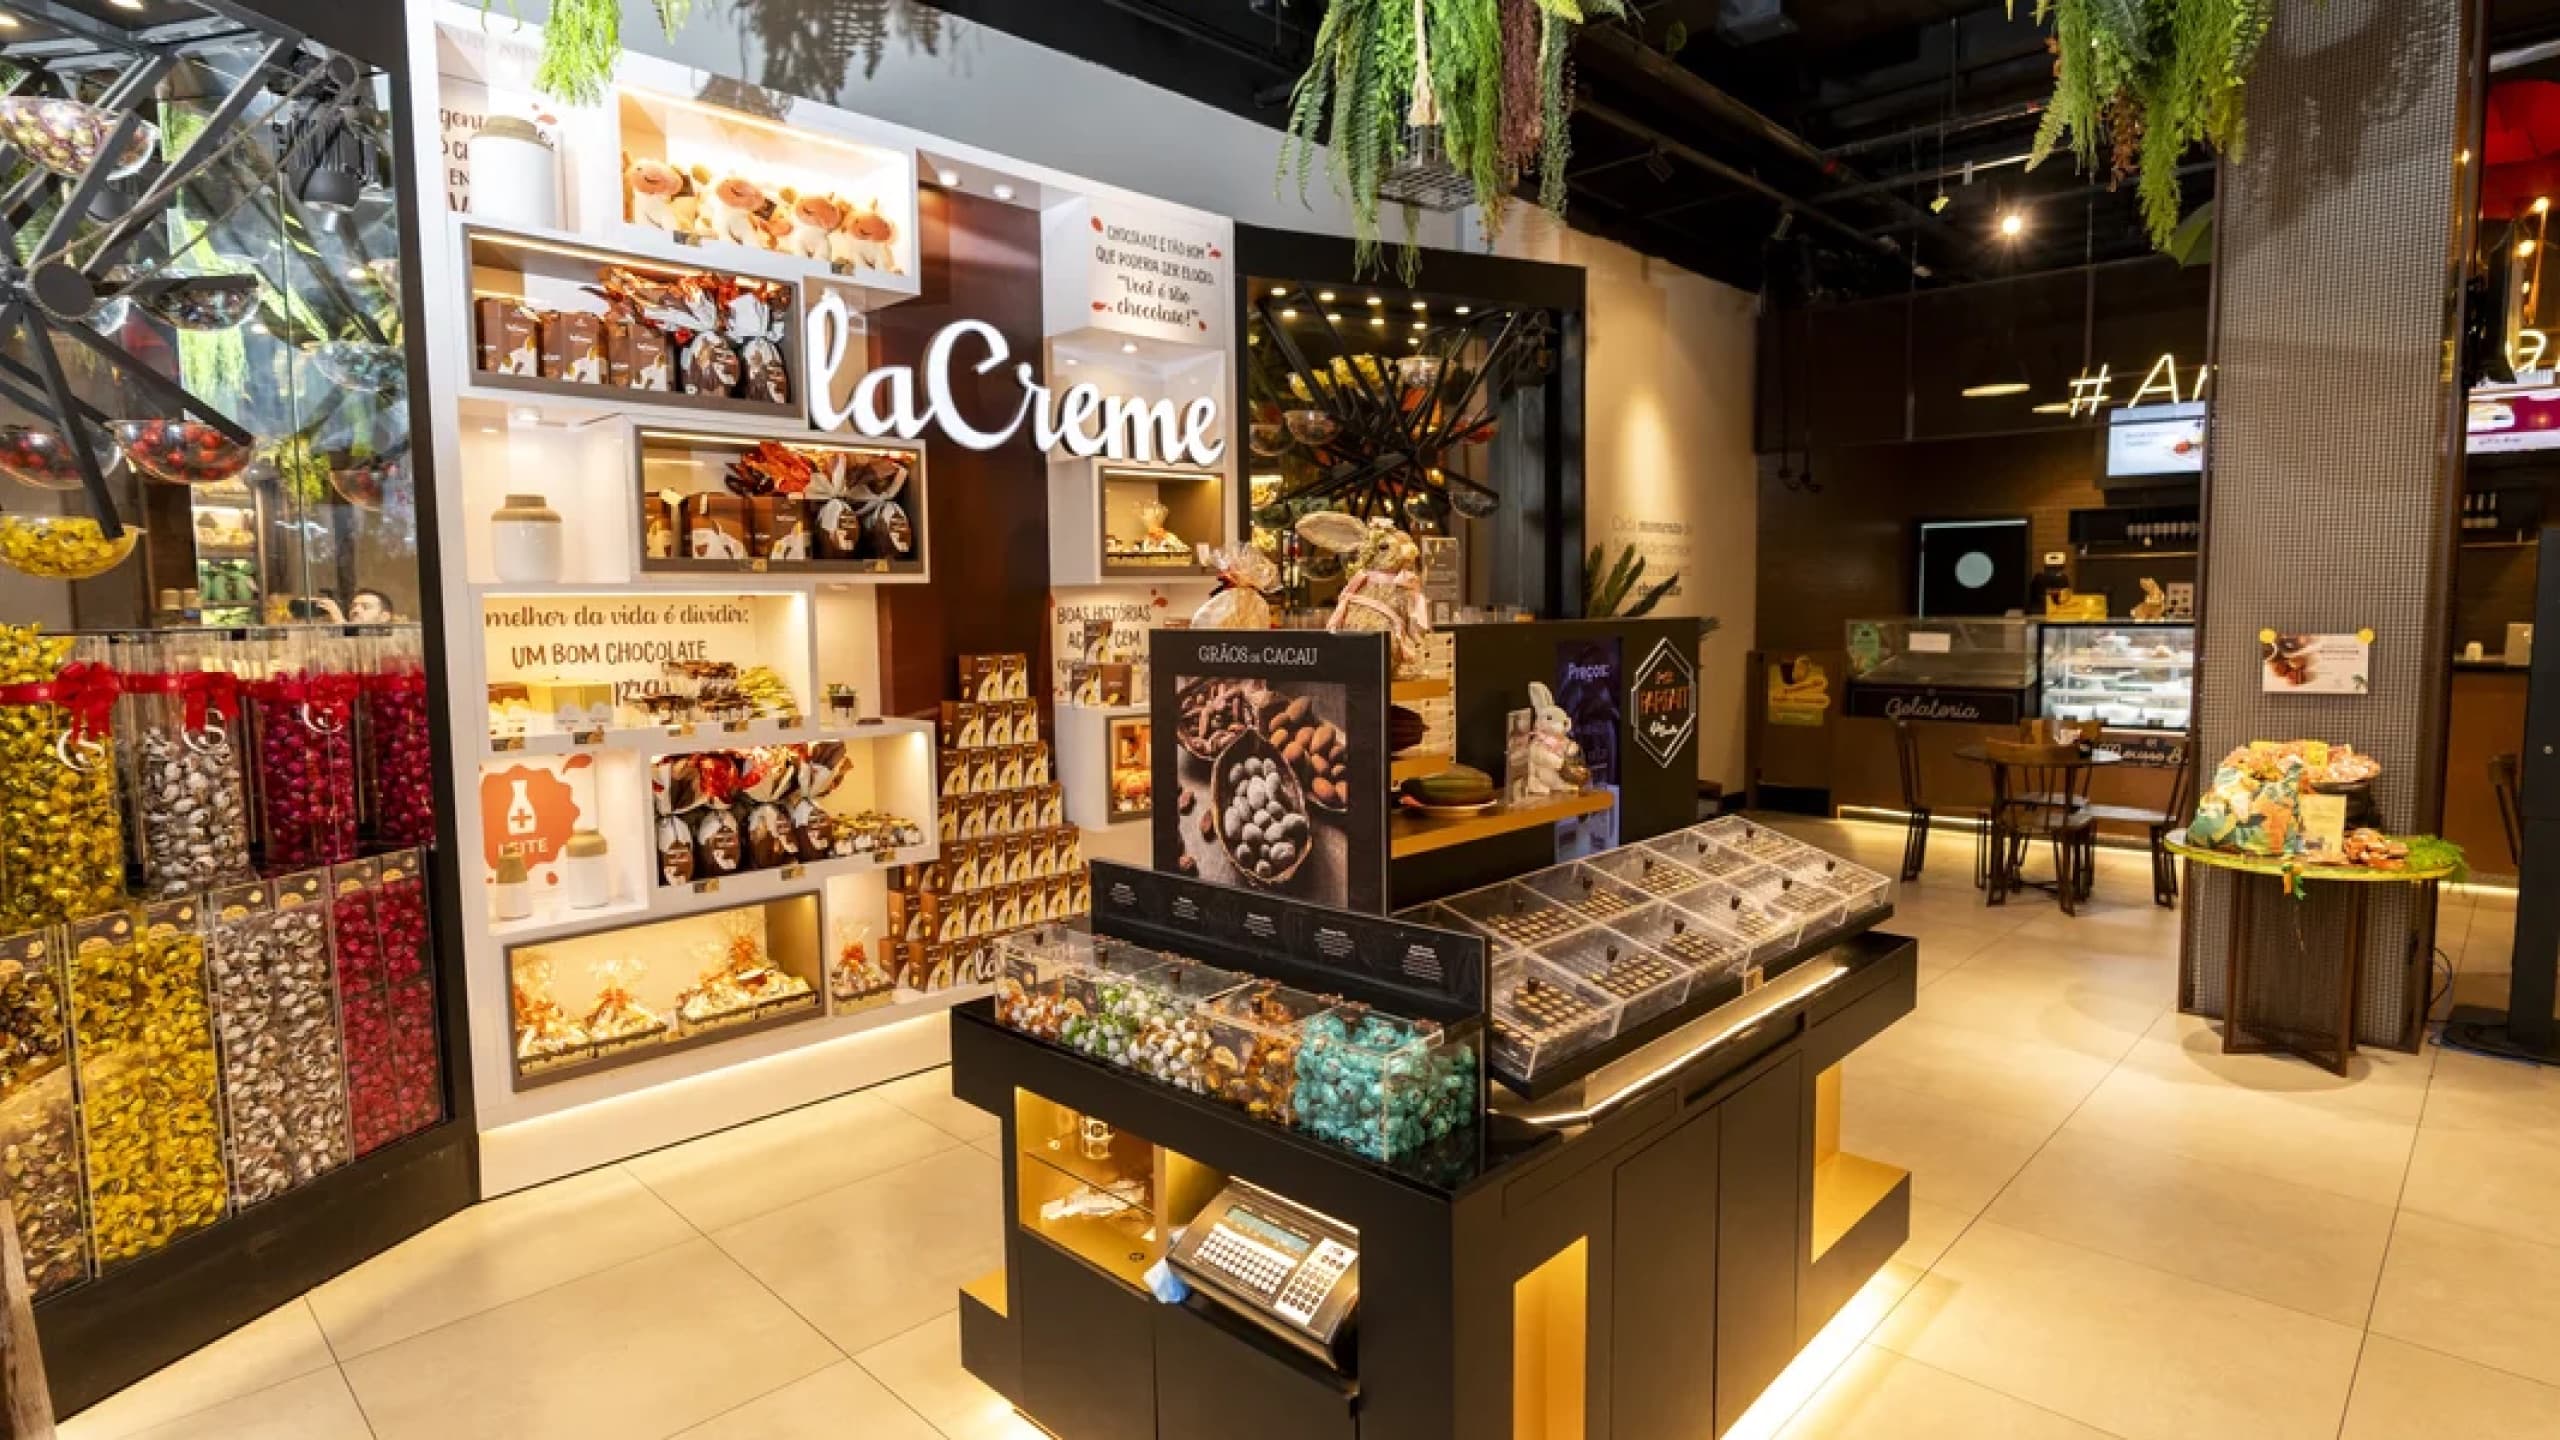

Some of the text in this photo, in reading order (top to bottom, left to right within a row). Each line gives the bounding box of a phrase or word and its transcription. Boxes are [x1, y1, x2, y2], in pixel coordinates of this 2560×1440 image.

[807, 289, 1226, 466] laCreme
[485, 604, 750, 627] melhor da vida é dividir:
[1056, 604, 1090, 624] BOAS
[512, 640, 708, 669] UM BOM CHOCOLATE
[1198, 643, 1248, 664] GRÃOS
[1263, 647, 1318, 665] CACAU
[1885, 696, 1980, 719] Gelateria
